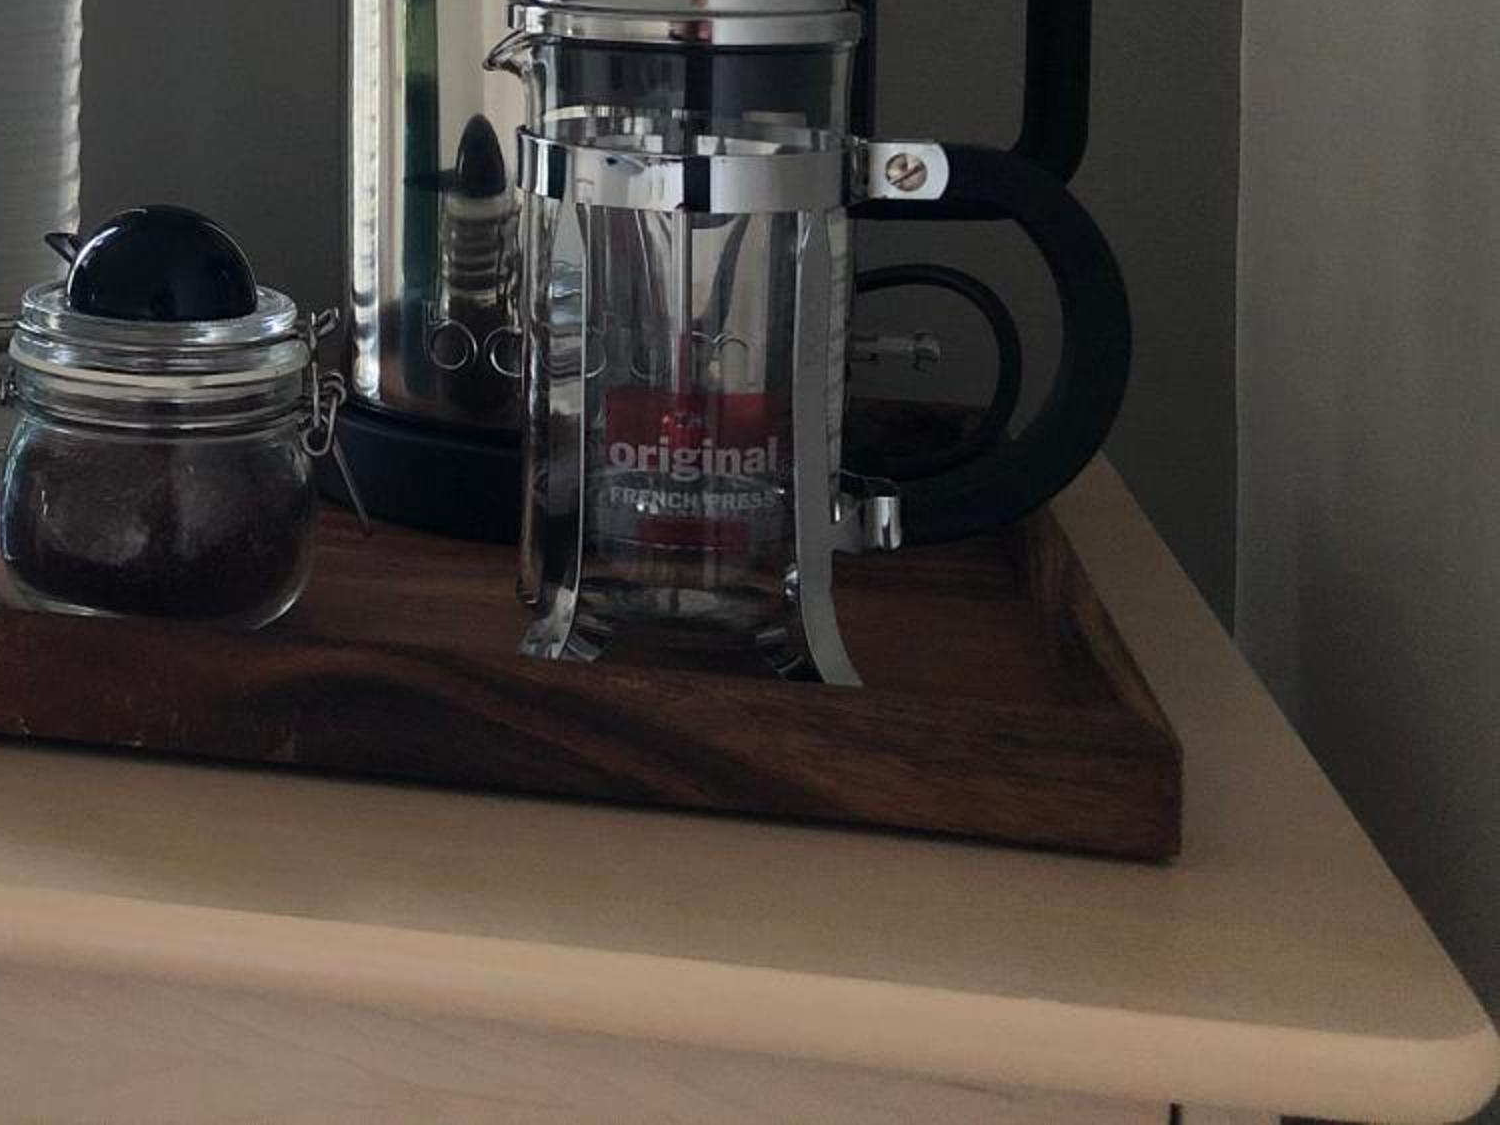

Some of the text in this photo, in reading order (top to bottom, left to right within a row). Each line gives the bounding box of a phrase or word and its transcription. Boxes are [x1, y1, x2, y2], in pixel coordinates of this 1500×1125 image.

[609, 436, 778, 482] original
[609, 486, 777, 510] FRENCH PRESS
